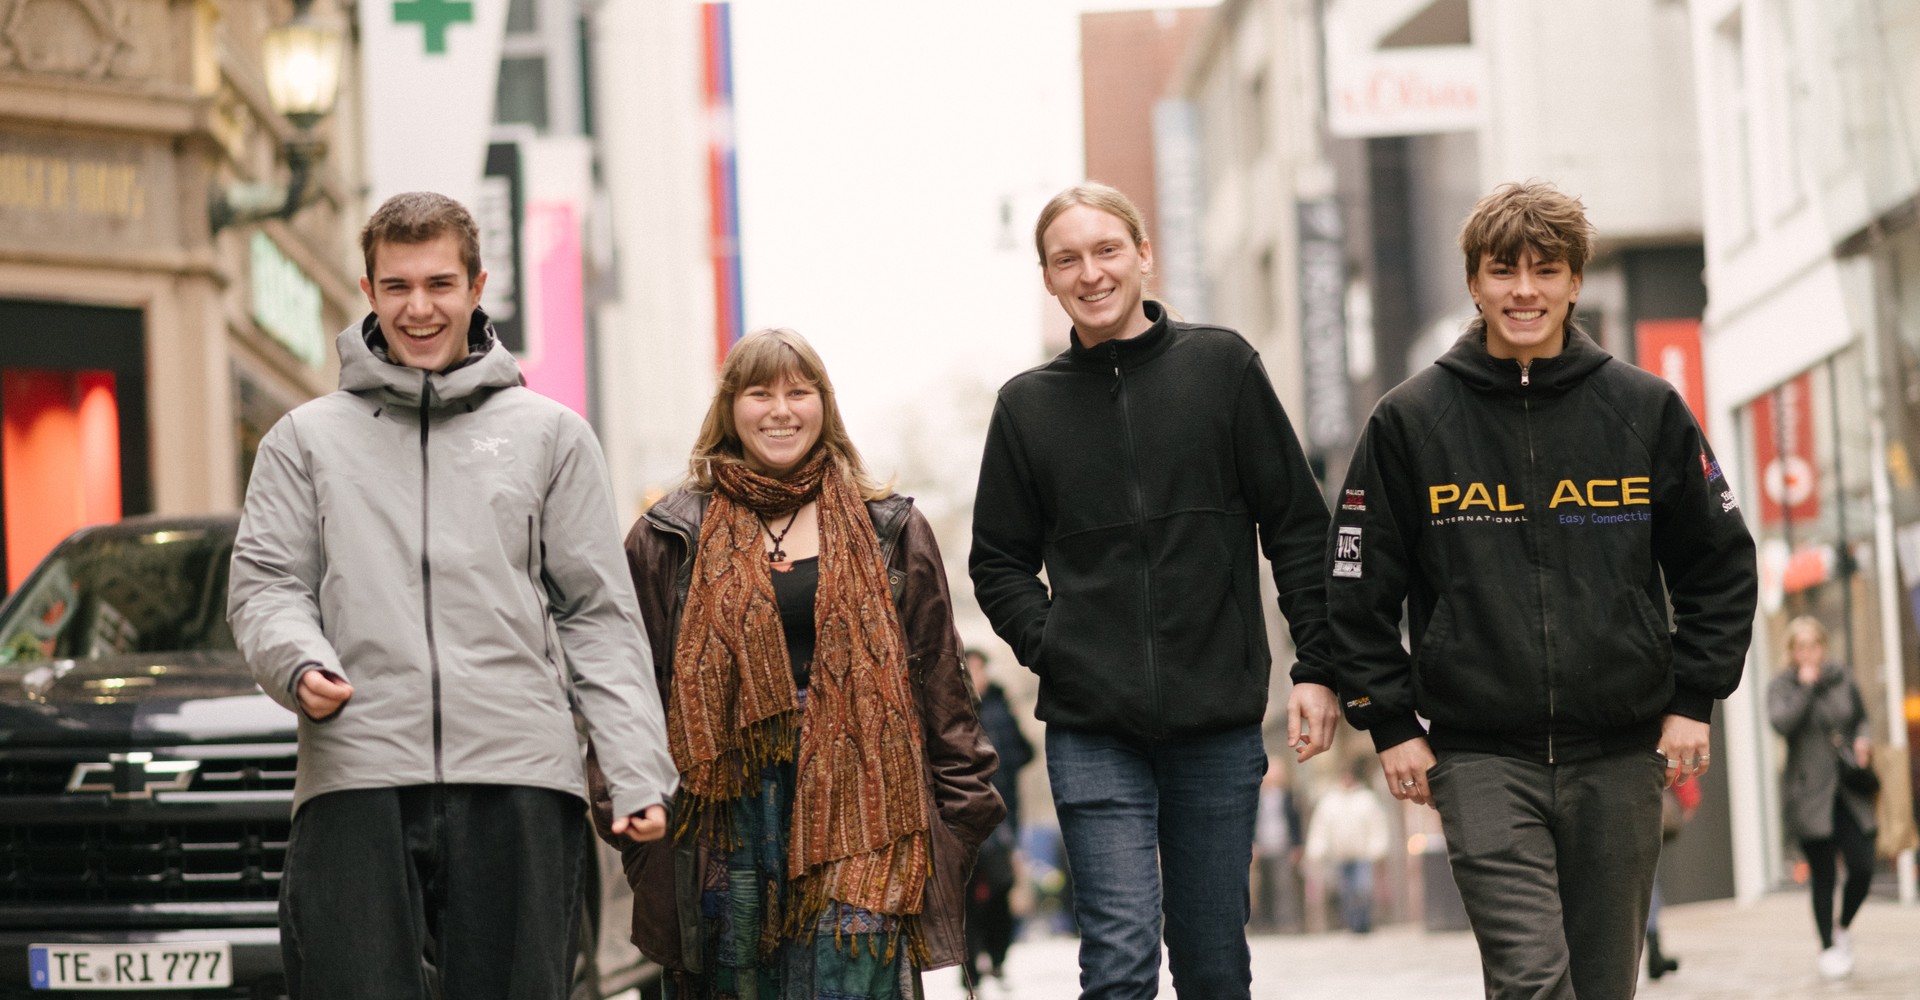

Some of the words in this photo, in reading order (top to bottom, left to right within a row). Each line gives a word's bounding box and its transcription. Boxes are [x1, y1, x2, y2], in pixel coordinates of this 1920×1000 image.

[1431, 515, 1528, 526] INTERNATIONAL
[1559, 513, 1586, 525] Easy
[1338, 535, 1360, 560] VHS
[53, 953, 92, 982] TE
[115, 953, 154, 982] RI
[162, 951, 222, 981] 777
